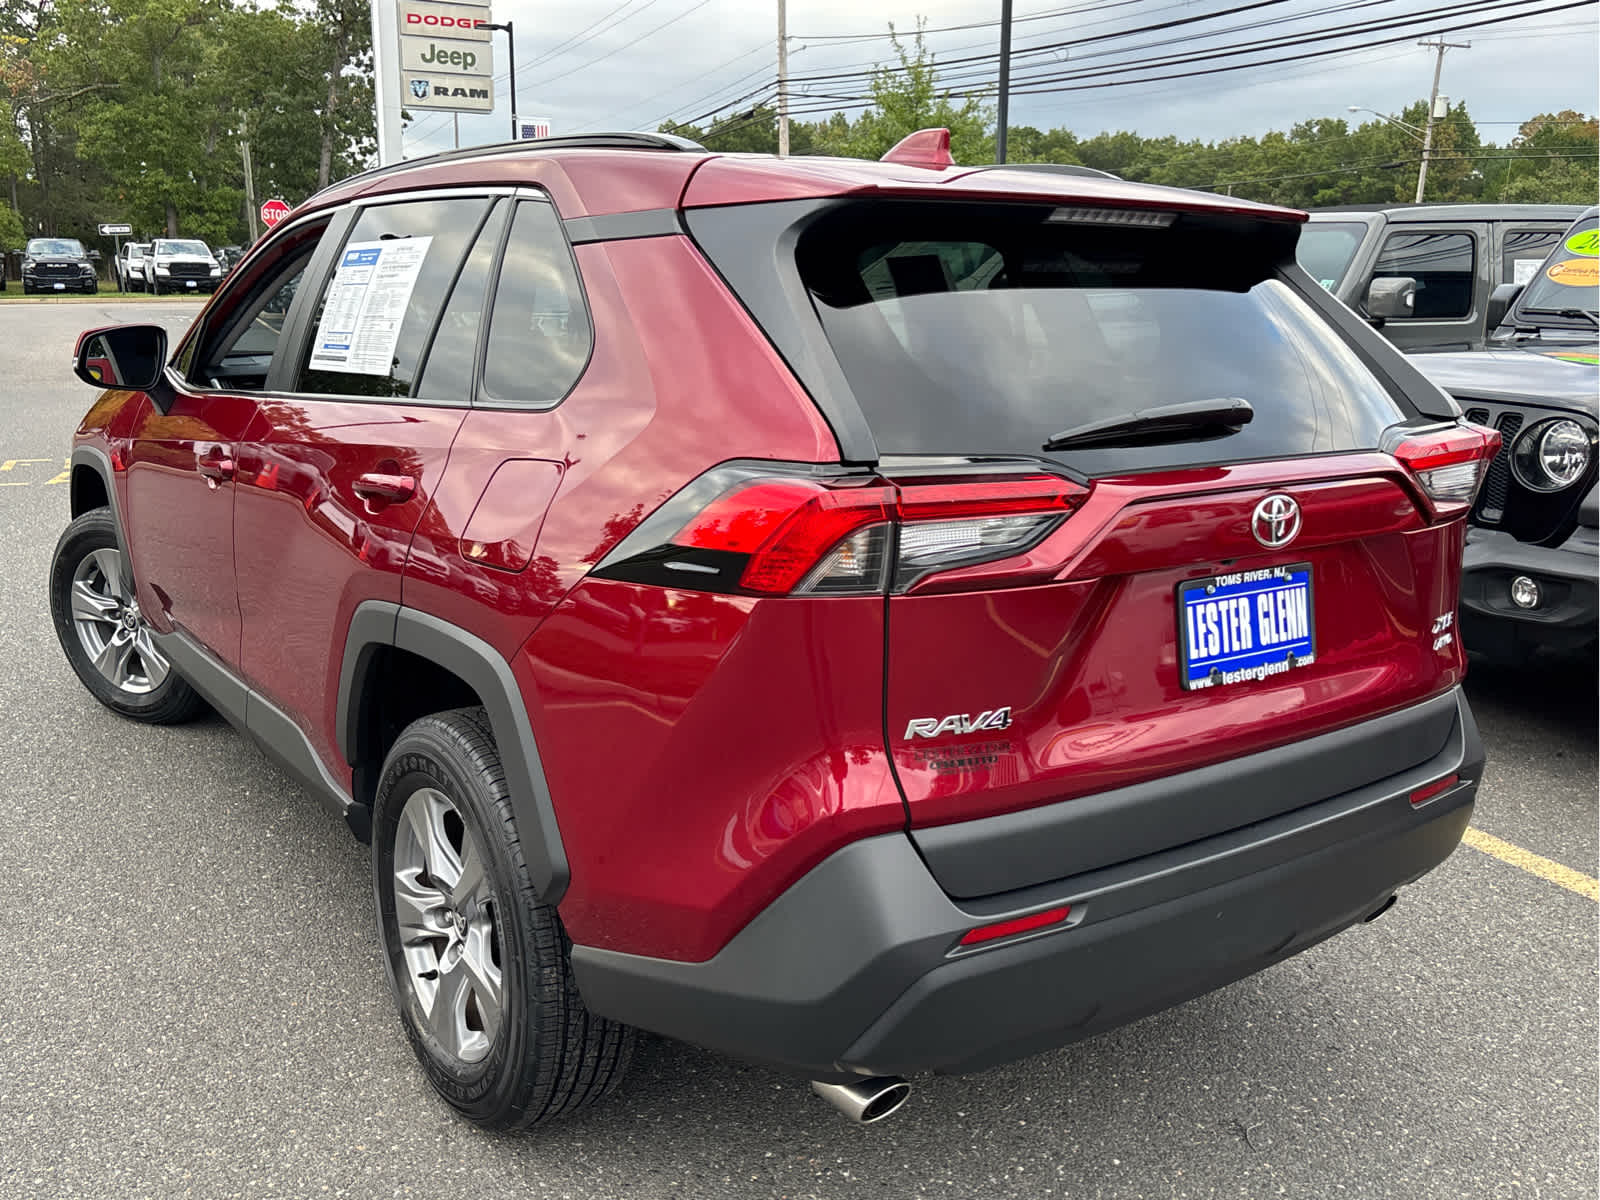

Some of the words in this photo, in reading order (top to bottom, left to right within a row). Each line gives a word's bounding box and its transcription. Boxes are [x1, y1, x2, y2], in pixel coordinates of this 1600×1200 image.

[420, 43, 476, 70] Jeep
[433, 86, 489, 99] RAM
[263, 208, 289, 220] STOP
[1215, 573, 1242, 587] TOMS
[1243, 569, 1272, 583] RIVER,
[1273, 566, 1286, 578] NJ
[1187, 597, 1253, 660] LESTER
[1257, 586, 1308, 646] GLENN
[904, 706, 1013, 740] RAV4
